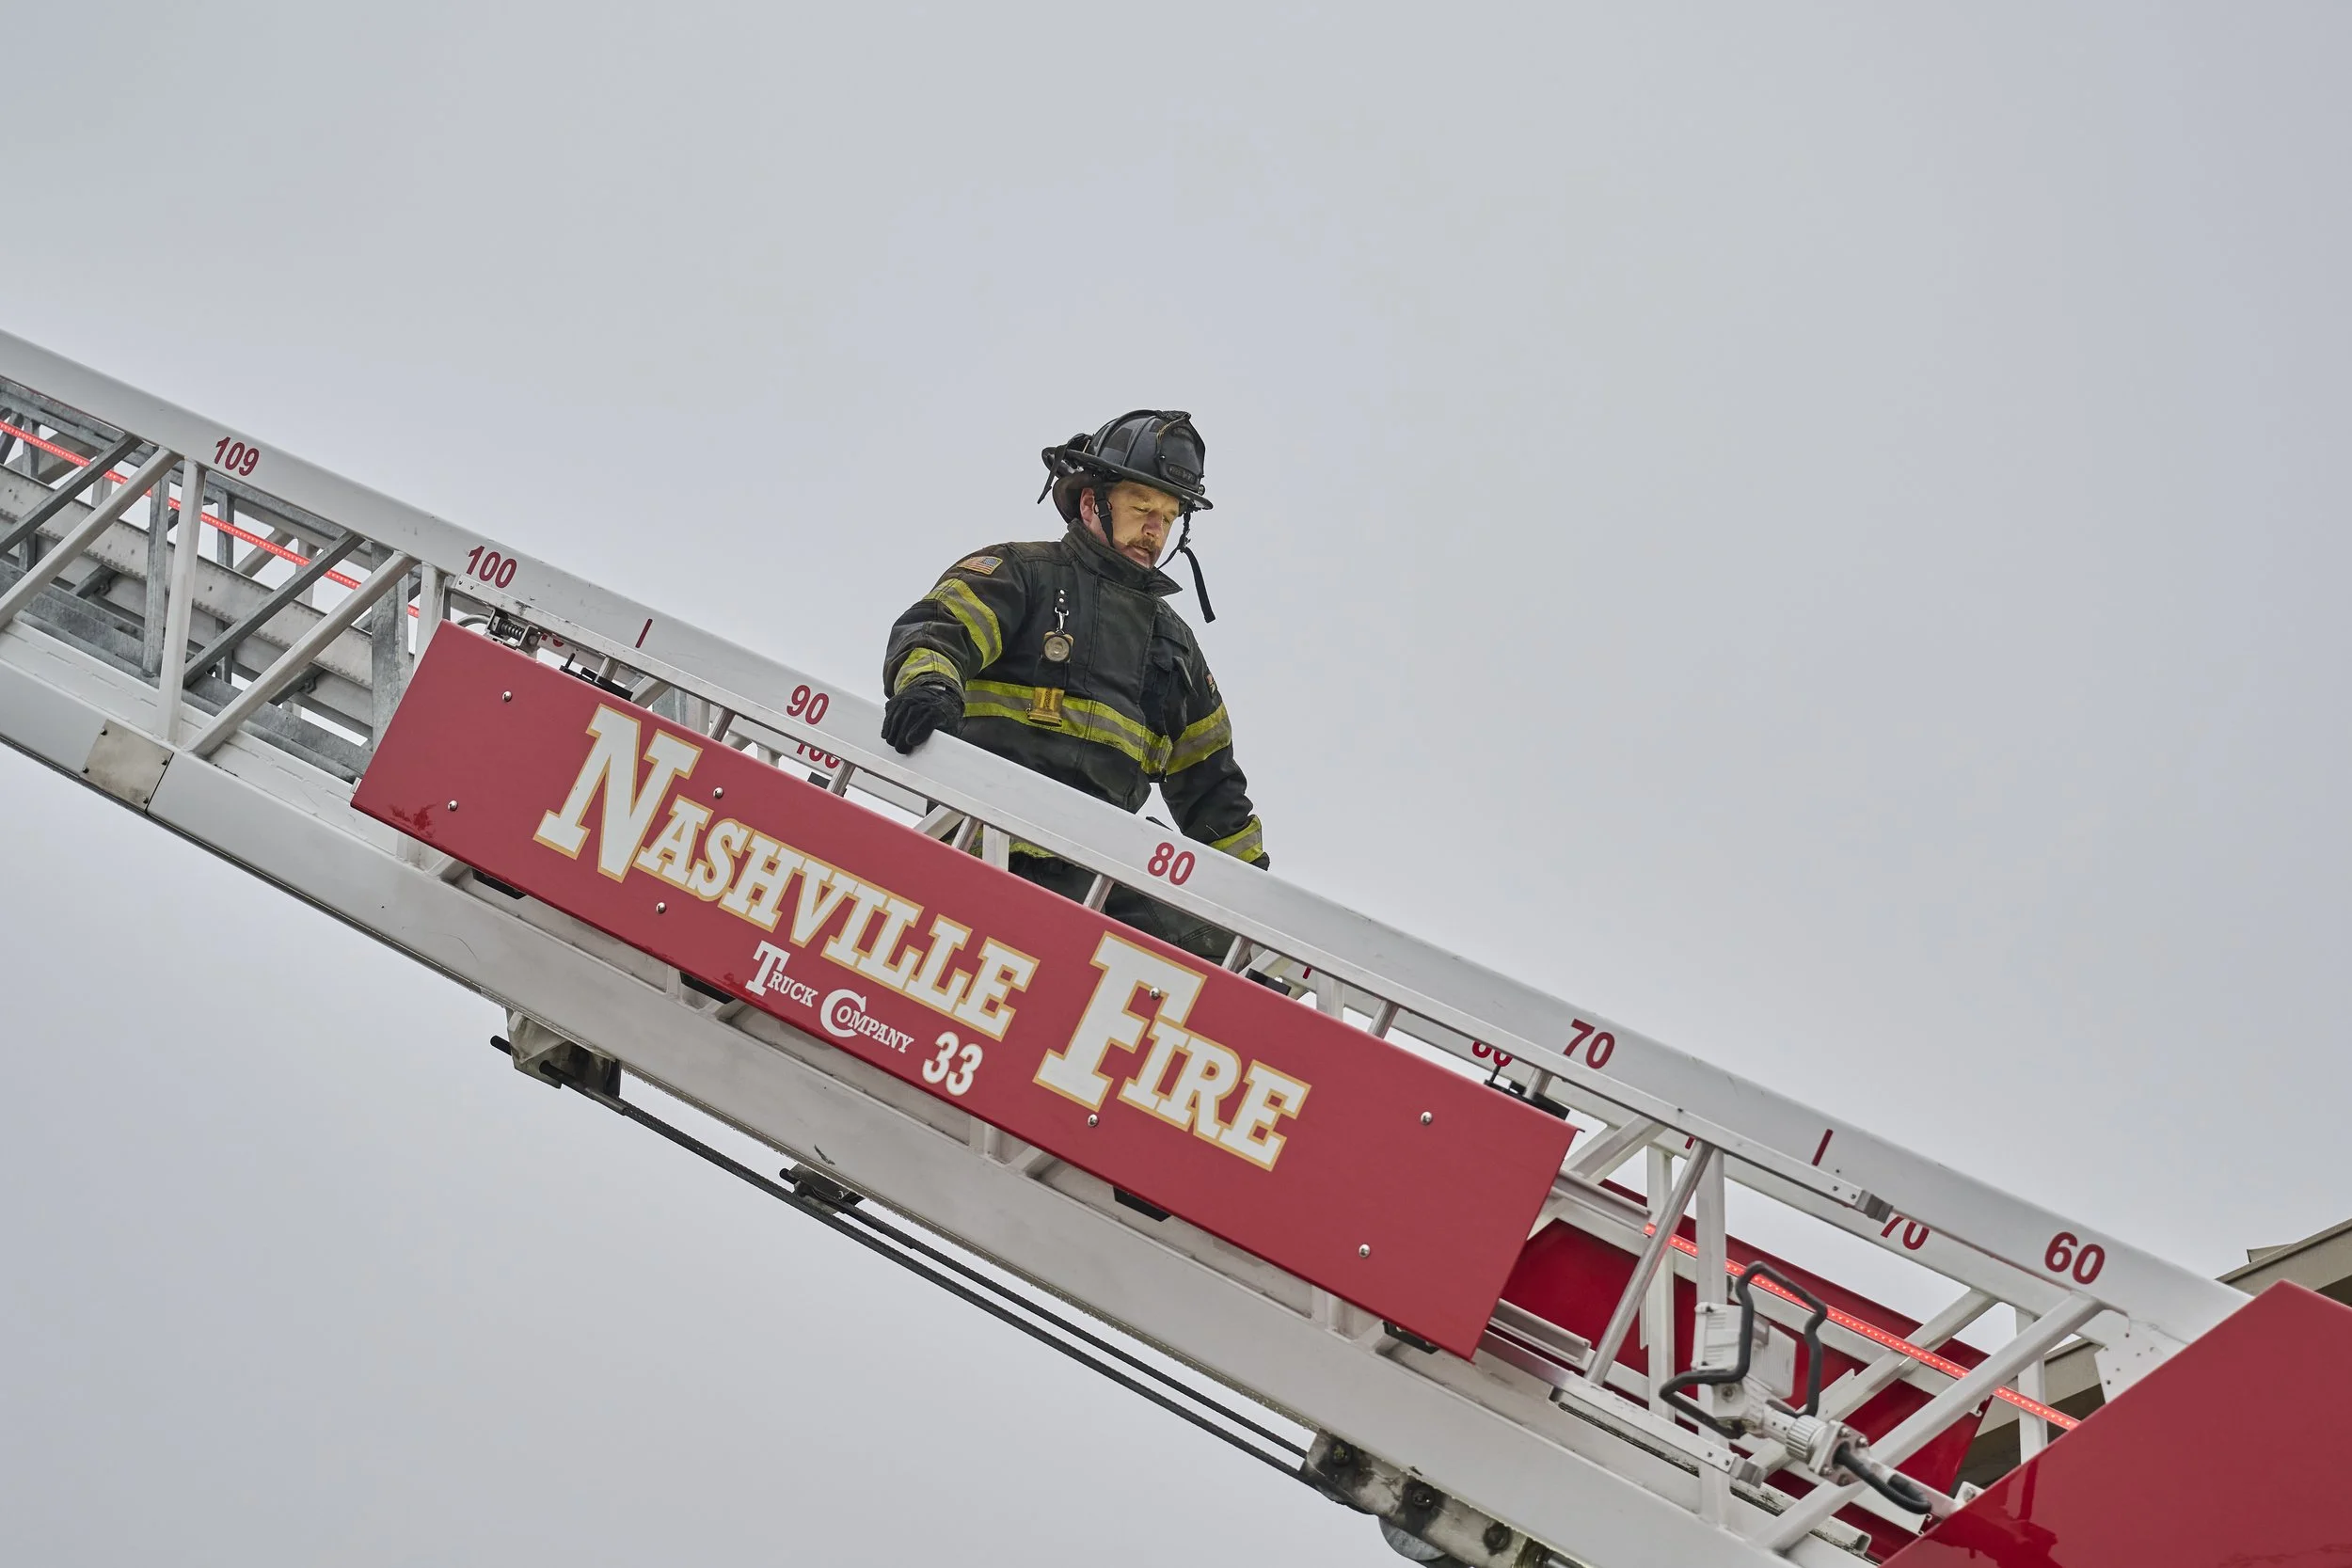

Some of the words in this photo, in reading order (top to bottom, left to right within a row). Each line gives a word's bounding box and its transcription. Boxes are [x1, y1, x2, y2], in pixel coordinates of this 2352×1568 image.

[215, 437, 260, 476] 109
[467, 546, 517, 588] 100
[787, 685, 830, 725] 90
[1147, 842, 1196, 886] 80
[532, 704, 1041, 1043] NASHVILLE
[1033, 929, 1312, 1173] FIRE
[744, 940, 818, 1008] TRUCK
[819, 989, 915, 1054] COMPANY
[922, 1031, 984, 1097] 33
[1563, 1018, 1615, 1069] 70
[2043, 1231, 2106, 1286] 60
